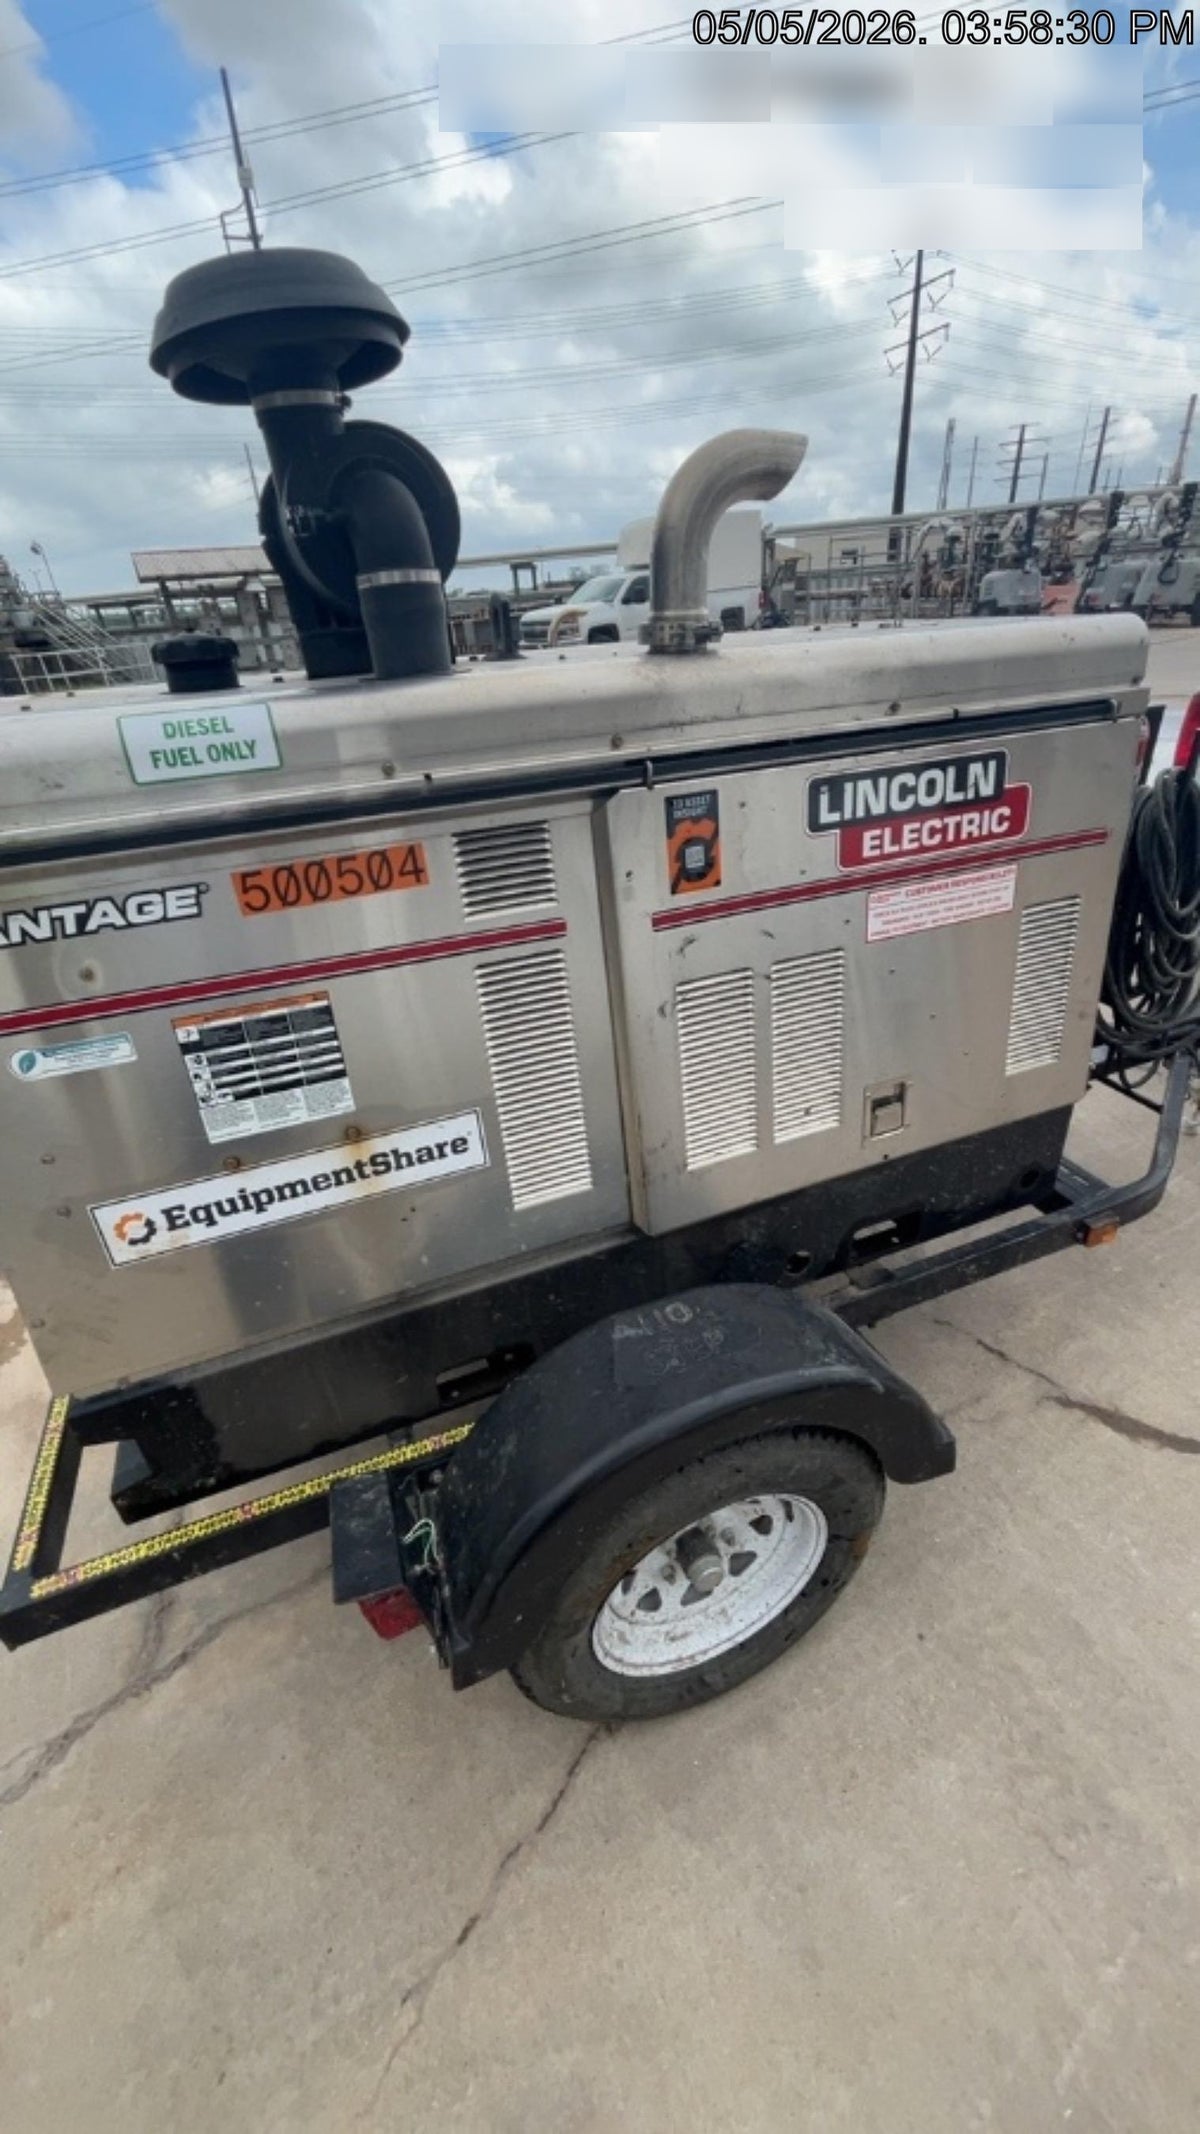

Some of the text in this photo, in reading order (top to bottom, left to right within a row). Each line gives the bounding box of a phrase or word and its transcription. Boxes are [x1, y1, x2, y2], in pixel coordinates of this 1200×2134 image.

[149, 739, 257, 769] FUEL ONLY
[162, 716, 235, 739] DIESEL
[819, 760, 997, 825] LINCOLN
[862, 806, 1012, 859] ELECTRIC
[240, 844, 425, 912] 500504
[0, 885, 201, 945] NTAGE
[161, 1135, 470, 1232] EquipmentShare
